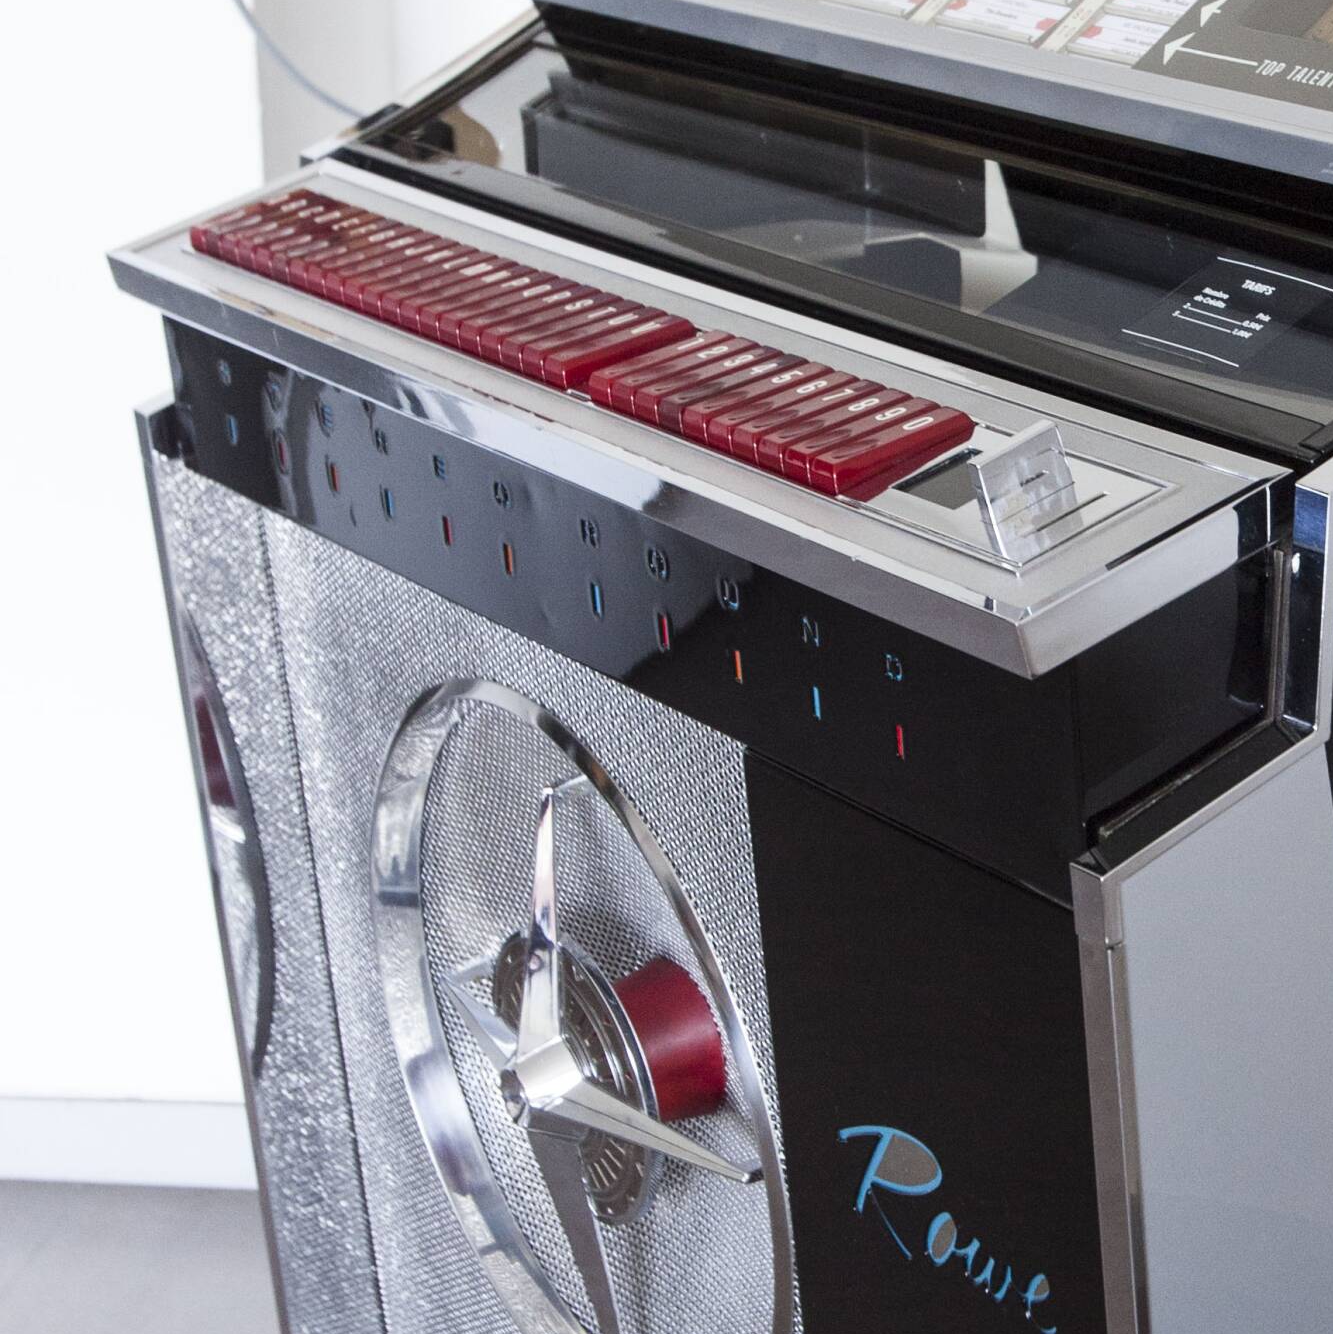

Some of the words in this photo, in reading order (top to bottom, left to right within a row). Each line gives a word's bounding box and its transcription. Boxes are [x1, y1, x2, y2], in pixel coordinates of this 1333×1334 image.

[1255, 58, 1287, 77] TOP
[1241, 279, 1277, 295] TARIFS
[677, 336, 705, 351] 1
[696, 345, 730, 359] 2
[722, 353, 755, 369] 3
[748, 362, 779, 377] 4
[770, 369, 804, 385] 5
[795, 379, 829, 395] 6
[820, 387, 855, 402] 7
[846, 397, 881, 413] 8
[874, 406, 908, 422] 9
[901, 415, 935, 432] 0
